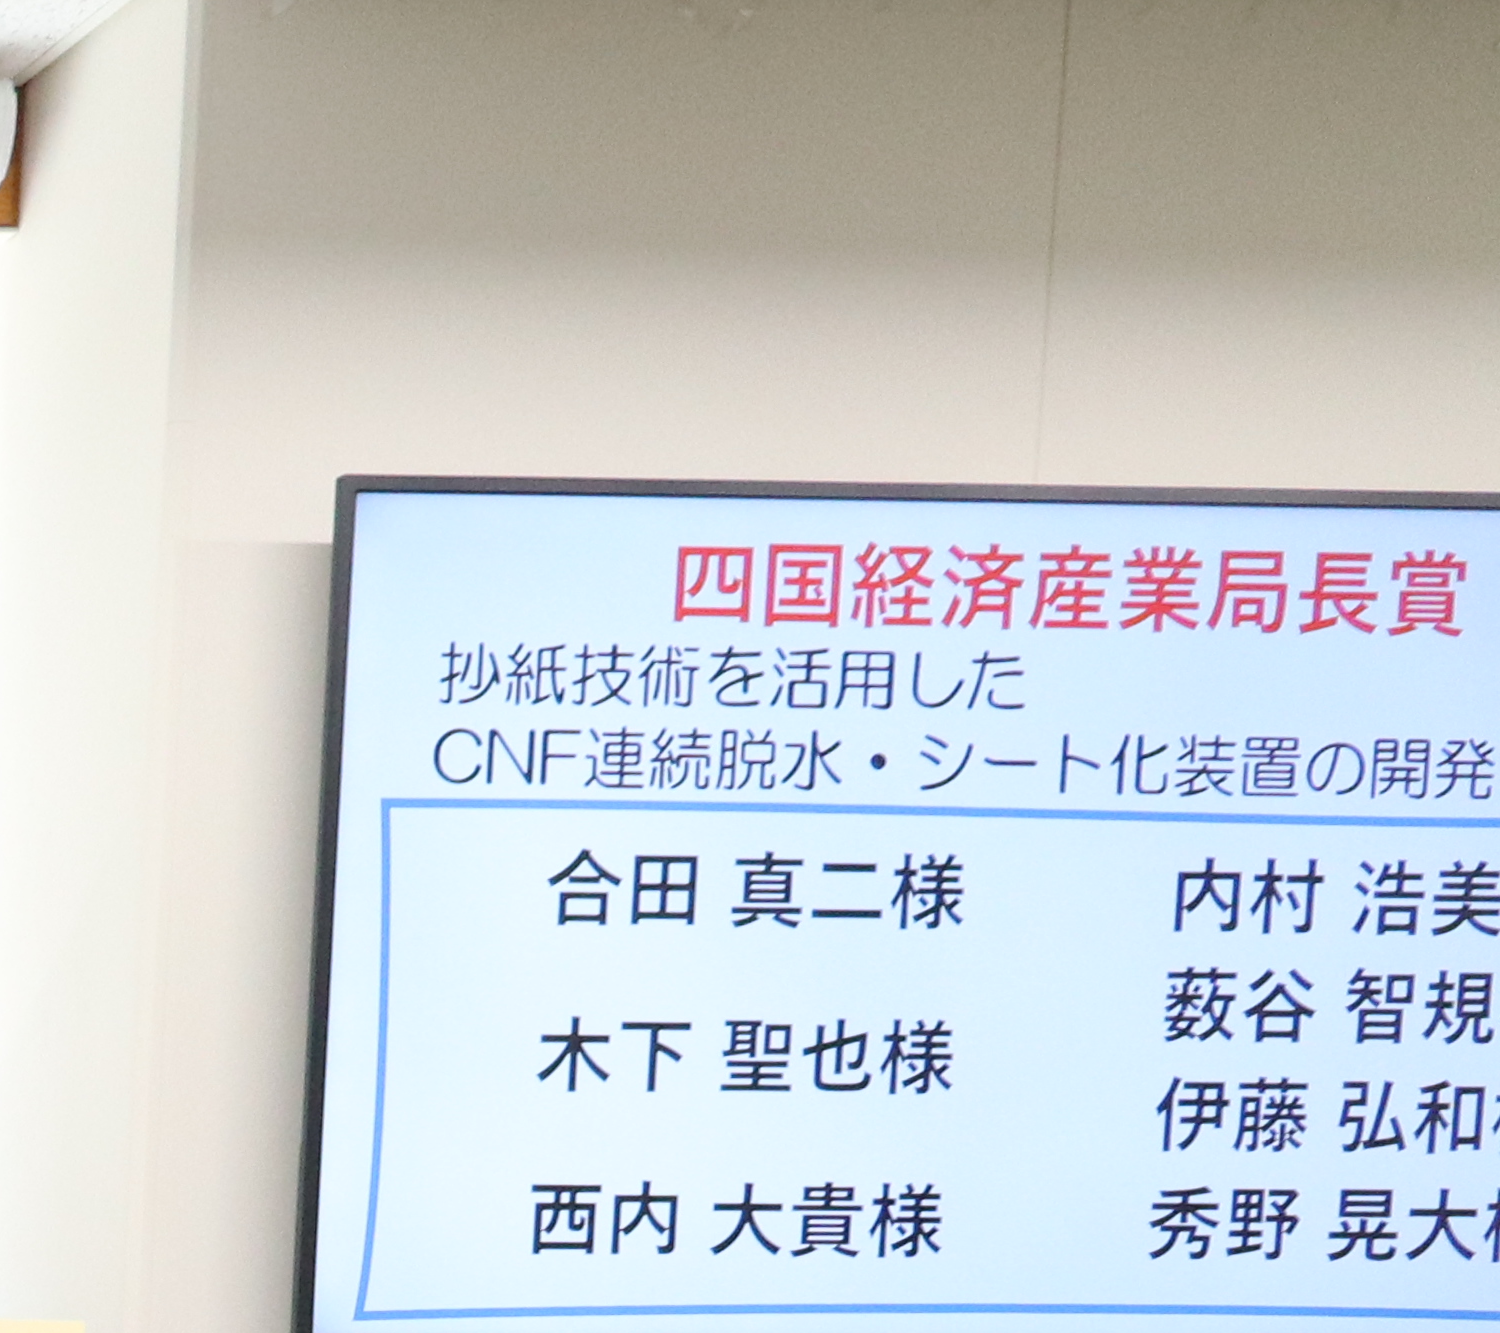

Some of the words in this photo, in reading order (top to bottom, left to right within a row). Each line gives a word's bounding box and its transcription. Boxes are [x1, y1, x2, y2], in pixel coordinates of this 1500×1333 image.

[673, 542, 1468, 638] 四国経済産業局長賞
[439, 641, 1026, 711] 抄紙技術を活用した
[432, 726, 1495, 800] CNF連続脱水・シート化装置の開発
[547, 848, 699, 926] 合田
[731, 850, 965, 930] 真二様
[1173, 857, 1325, 935] 内村
[536, 1015, 693, 1093] 木下
[720, 1018, 954, 1095] 聖也様
[1156, 1076, 1309, 1153] 伊藤
[1338, 1079, 1500, 1155] 弘和
[531, 1180, 679, 1255] 西内
[710, 1181, 943, 1259] 大貴様
[1148, 1185, 1300, 1261] 秀野
[1327, 1187, 1500, 1264] 晃大
